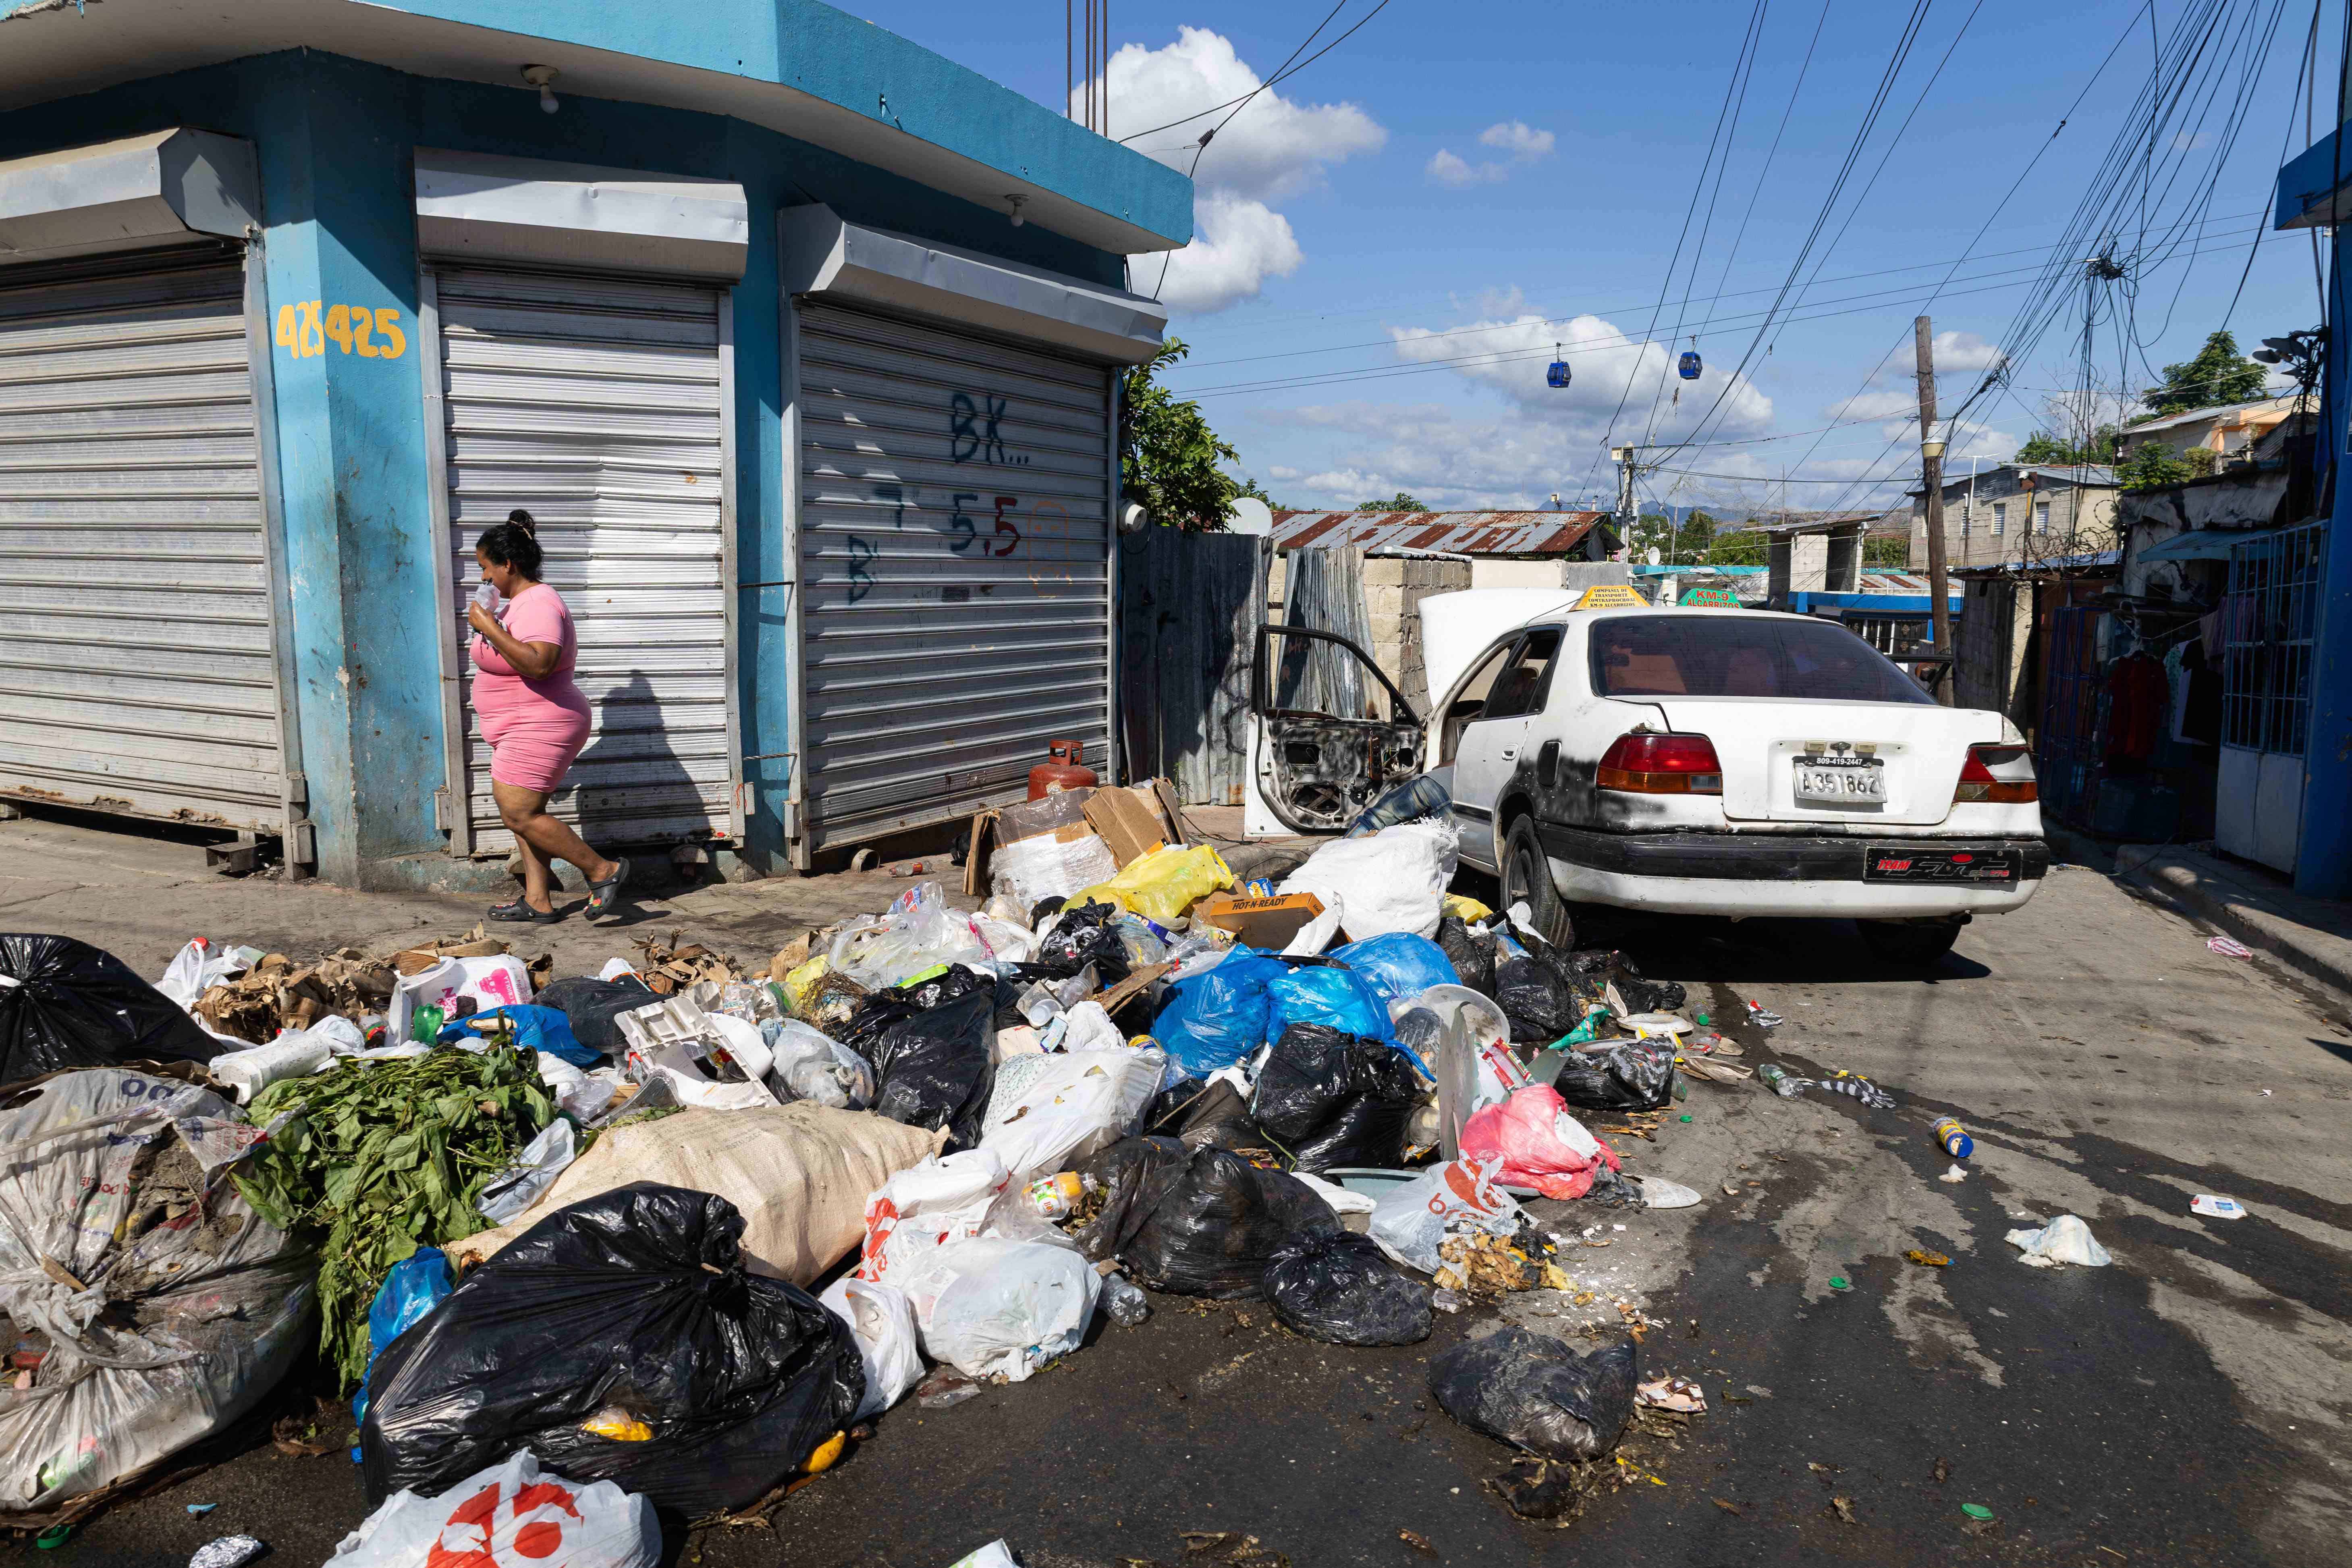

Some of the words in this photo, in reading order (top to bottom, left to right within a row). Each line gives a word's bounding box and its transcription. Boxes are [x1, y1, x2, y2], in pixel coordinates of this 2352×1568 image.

[324, 304, 406, 359] 425
[1696, 590, 1729, 601] KM-9
[1687, 598, 1739, 609] ALCARRIZOS
[1876, 859, 1912, 870] TEAM
[1232, 896, 1289, 910] HOT-N-READY
